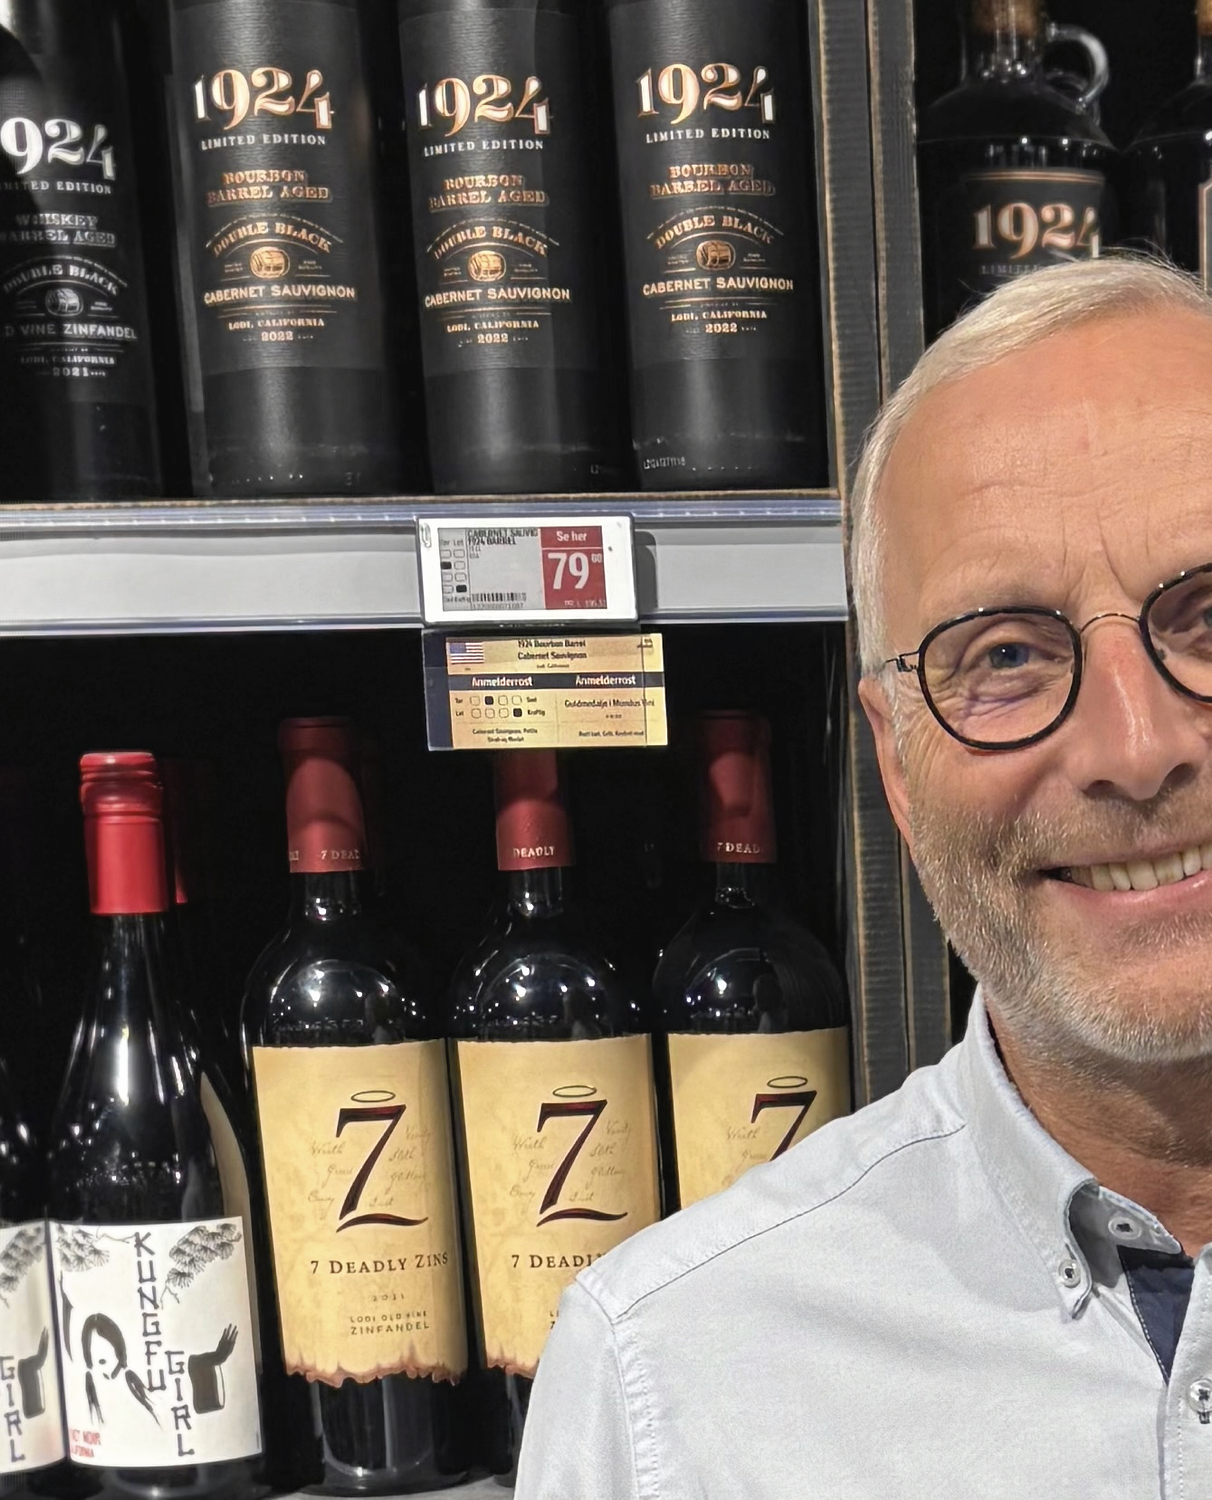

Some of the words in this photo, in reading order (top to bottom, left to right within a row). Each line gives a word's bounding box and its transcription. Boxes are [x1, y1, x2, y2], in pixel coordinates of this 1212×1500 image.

[194, 67, 334, 130] 1924
[635, 62, 775, 125] 1924
[417, 74, 553, 137] 1924
[201, 134, 255, 150] LIMITED
[263, 133, 326, 145] EDITION
[646, 129, 704, 144] LIMITED
[711, 128, 770, 139] EDITION
[0, 117, 115, 180] 924
[424, 141, 475, 157] LIMITED
[482, 139, 544, 150] EDITION
[223, 169, 305, 184] BOURBON
[669, 163, 751, 178] BOURBON
[56, 182, 111, 194] EDITION
[444, 174, 523, 189] BOURBON
[650, 180, 721, 196] BARREL
[729, 180, 774, 193] AGED
[207, 186, 273, 203] BARREL
[280, 186, 329, 199] AGED
[429, 190, 491, 208] BARREL
[498, 190, 546, 203] AGED
[74, 230, 115, 245] AGED
[213, 222, 268, 257] DOUBLE
[275, 222, 332, 253] BLACK
[656, 215, 715, 249] DOUBLE
[722, 215, 775, 245] BLACK
[972, 202, 1101, 260] 1924
[434, 226, 487, 259] DOUBLE
[492, 226, 548, 256] BLACK
[69, 264, 118, 295] BLACK
[643, 278, 711, 296] CABERNET
[716, 277, 794, 290] SAUVIGNON
[204, 286, 265, 305] CABERNET
[271, 285, 355, 298] SAUVIGNON
[424, 289, 482, 307] CABERNET
[487, 287, 570, 300] SAUVIGNON
[257, 318, 325, 327] CALIFORNIA
[702, 310, 767, 319] CALIFORNIA
[64, 323, 137, 340] ZINFANDEL
[474, 320, 539, 330] CALIFORNIA
[705, 323, 738, 333] 2022
[261, 331, 293, 341] 2022
[477, 333, 508, 343] 2022
[557, 531, 570, 541] Se
[572, 531, 587, 541] her
[548, 552, 589, 590] 79
[565, 639, 586, 648] Barrel
[518, 652, 550, 660] Cabernet
[551, 651, 587, 660] Sauvignon
[472, 676, 533, 686] Anmelderrost
[576, 675, 636, 685] Anmelderrost
[321, 850, 328, 860] 7
[513, 846, 555, 858] DEADLY
[751, 1090, 817, 1162] 7
[336, 1104, 407, 1220] 7
[537, 1099, 608, 1214] 7
[311, 1260, 319, 1274] 7
[329, 1258, 407, 1274] DEADLY
[415, 1251, 448, 1268] ZINS
[511, 1254, 520, 1268] 7
[350, 1315, 376, 1323] LODI
[381, 1313, 401, 1322] OLD
[350, 1321, 429, 1335] ZINFANDEL
[0, 1355, 25, 1462] GIRL
[165, 1350, 195, 1456] GIRL
